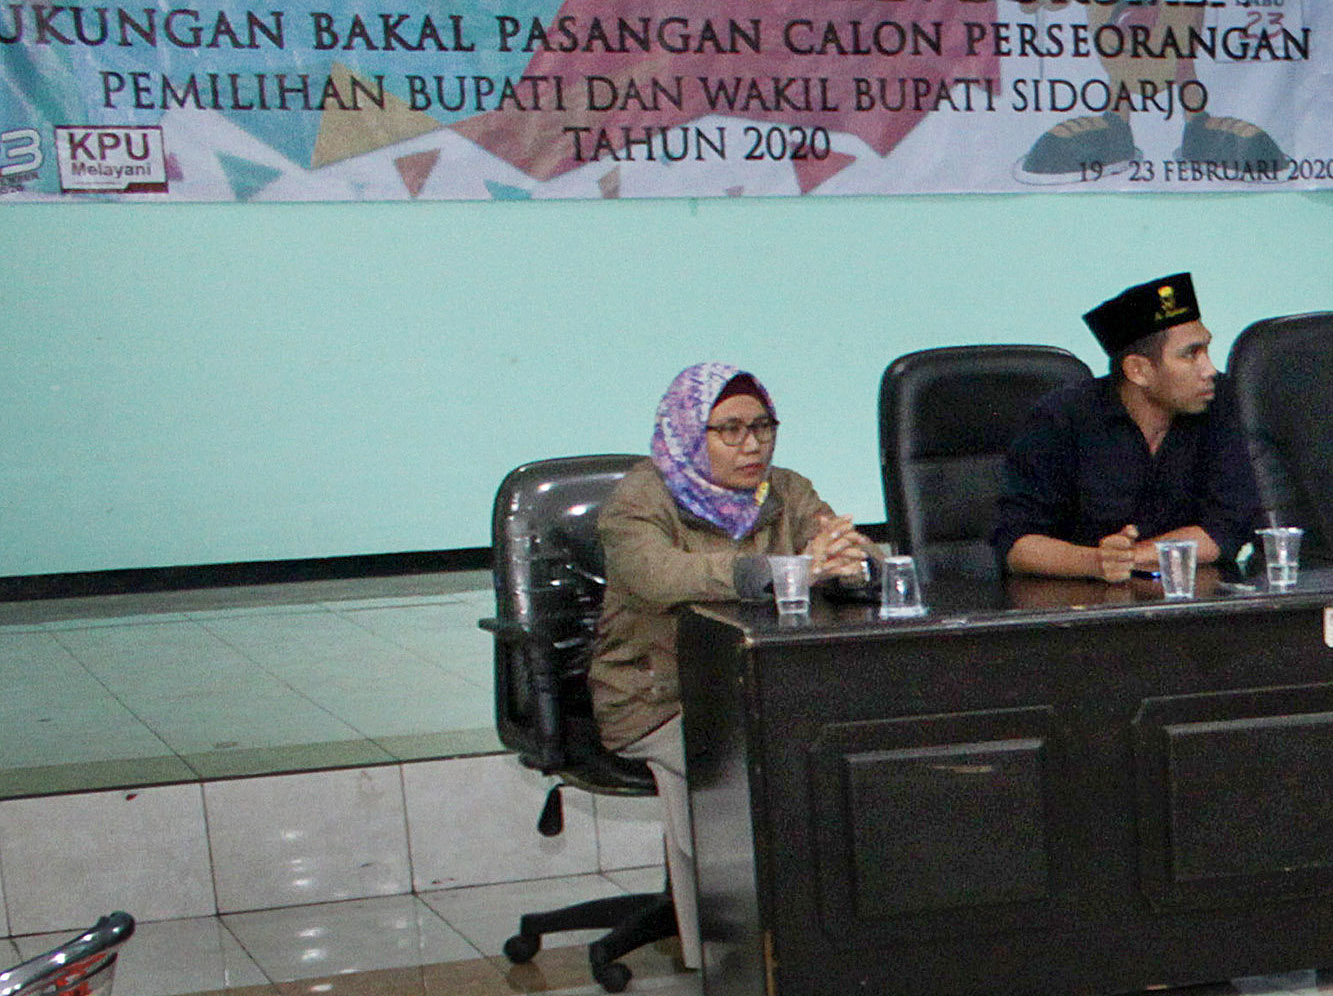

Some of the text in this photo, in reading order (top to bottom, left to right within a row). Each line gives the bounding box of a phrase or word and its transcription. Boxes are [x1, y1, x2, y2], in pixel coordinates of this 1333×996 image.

[312, 14, 476, 53] BAKAL
[495, 15, 763, 54] PASANGAN
[783, 19, 944, 57] CALON
[965, 22, 1312, 62] PERSEORANGAN
[100, 71, 1208, 121] PEMILIHAN BUPATI DAN WAKIL BUPATI SIDOARJO
[67, 132, 150, 161] KPU
[564, 126, 831, 163] TAHUN 2020
[71, 161, 152, 179] Melayani
[1080, 160, 1104, 182] 19
[1129, 161, 1155, 182] 23
[1164, 160, 1279, 182] FEBRUARI
